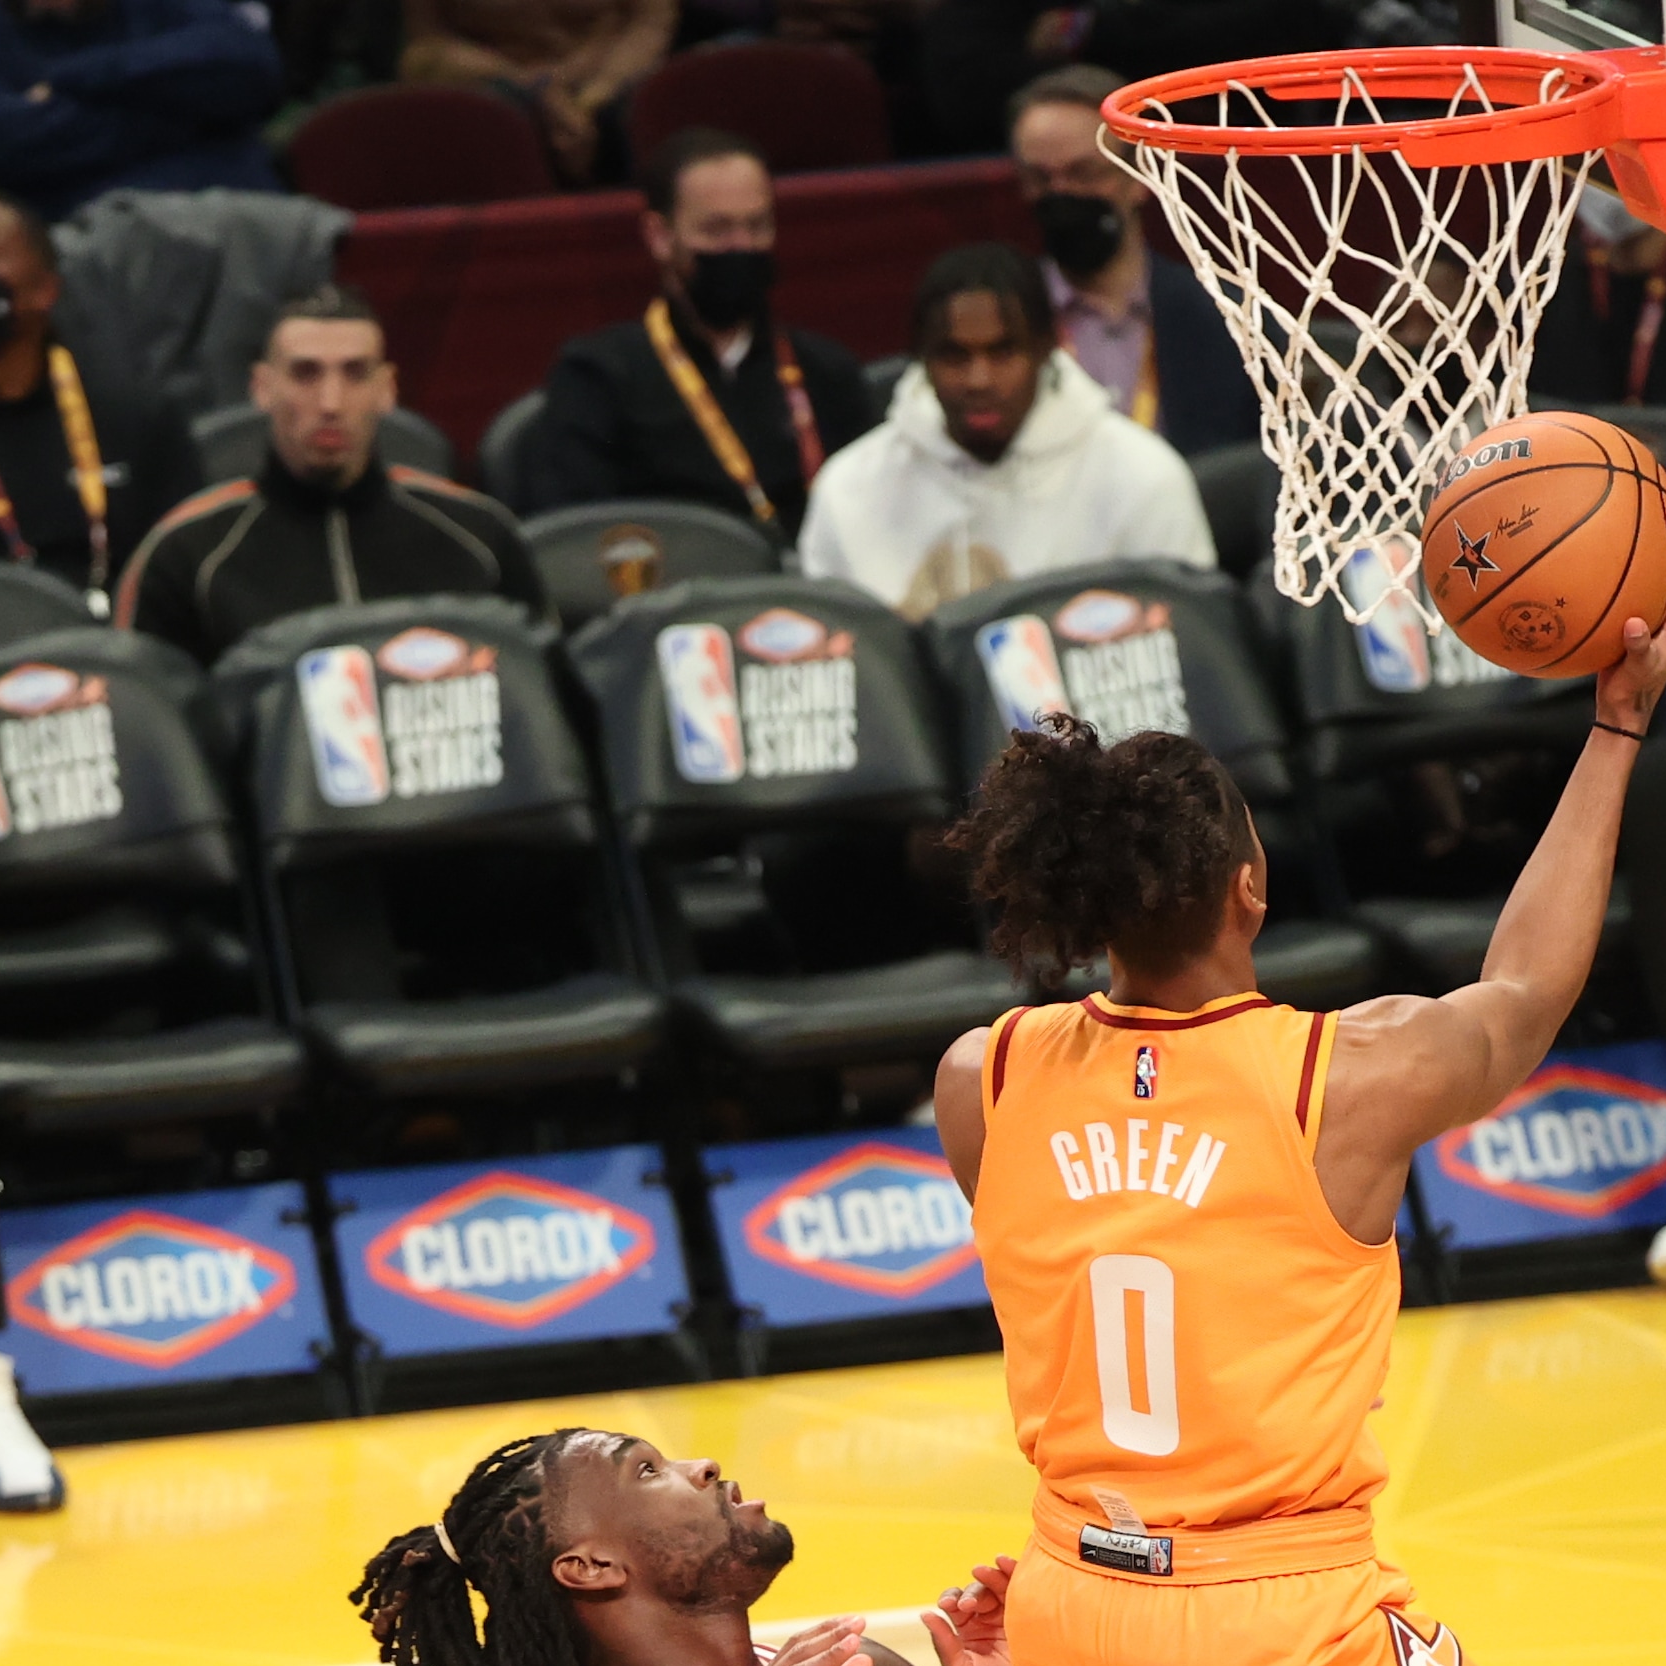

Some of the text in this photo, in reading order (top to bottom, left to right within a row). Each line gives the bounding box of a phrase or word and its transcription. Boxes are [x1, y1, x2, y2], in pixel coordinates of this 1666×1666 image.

[1049, 1118, 1227, 1208] GREEN
[400, 1207, 623, 1291] CLOROX
[776, 1181, 974, 1263] CLORO
[39, 1247, 263, 1330] CLOROX
[1089, 1253, 1180, 1456] 0
